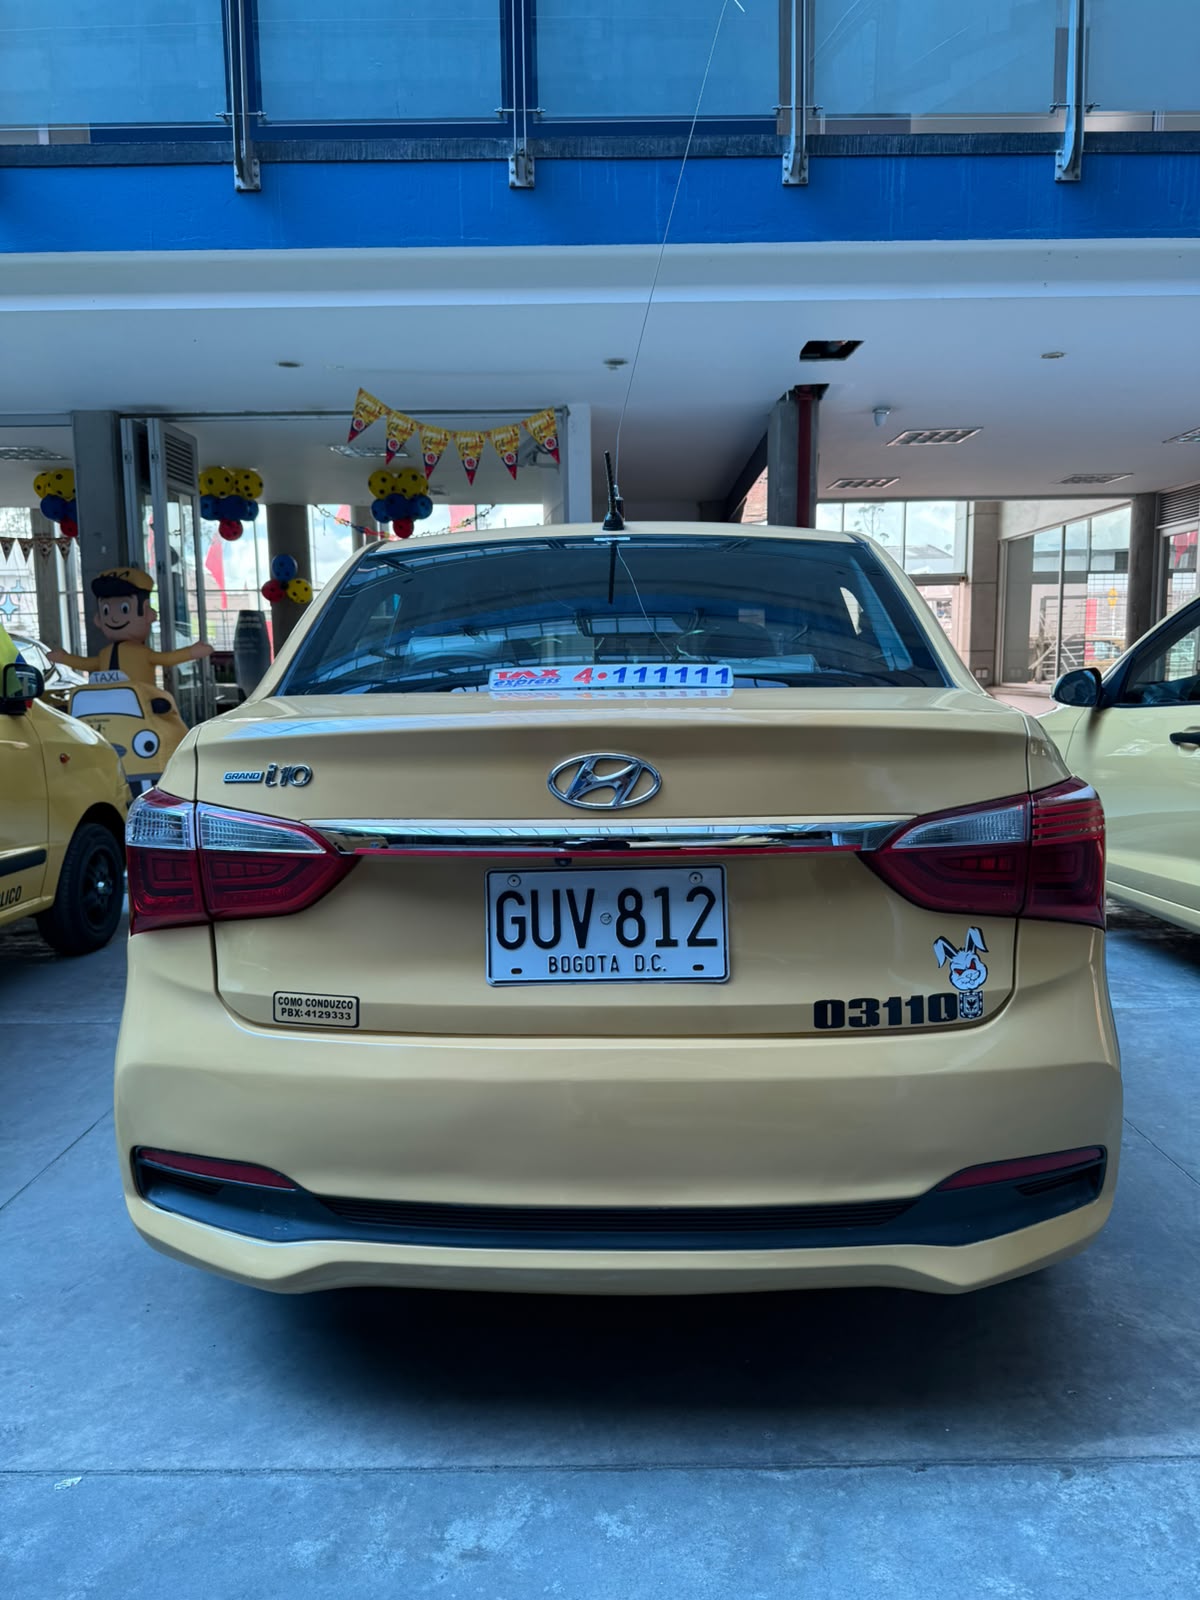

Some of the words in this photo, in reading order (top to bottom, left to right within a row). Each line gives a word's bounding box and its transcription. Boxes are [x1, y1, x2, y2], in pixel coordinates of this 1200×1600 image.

[94, 672, 120, 682] TAXI
[496, 669, 561, 680] TAX
[494, 677, 561, 688] express
[224, 772, 261, 780] GRAND
[265, 763, 313, 787] i10
[496, 888, 595, 950] GUV
[615, 886, 718, 948] 812
[548, 955, 620, 974] BOGOTA
[634, 954, 667, 972] D.C.
[277, 996, 303, 1007] COMO
[305, 998, 354, 1009] CONDUZCO
[281, 1008, 352, 1020] PBX:4129333
[813, 992, 958, 1029] 03110
